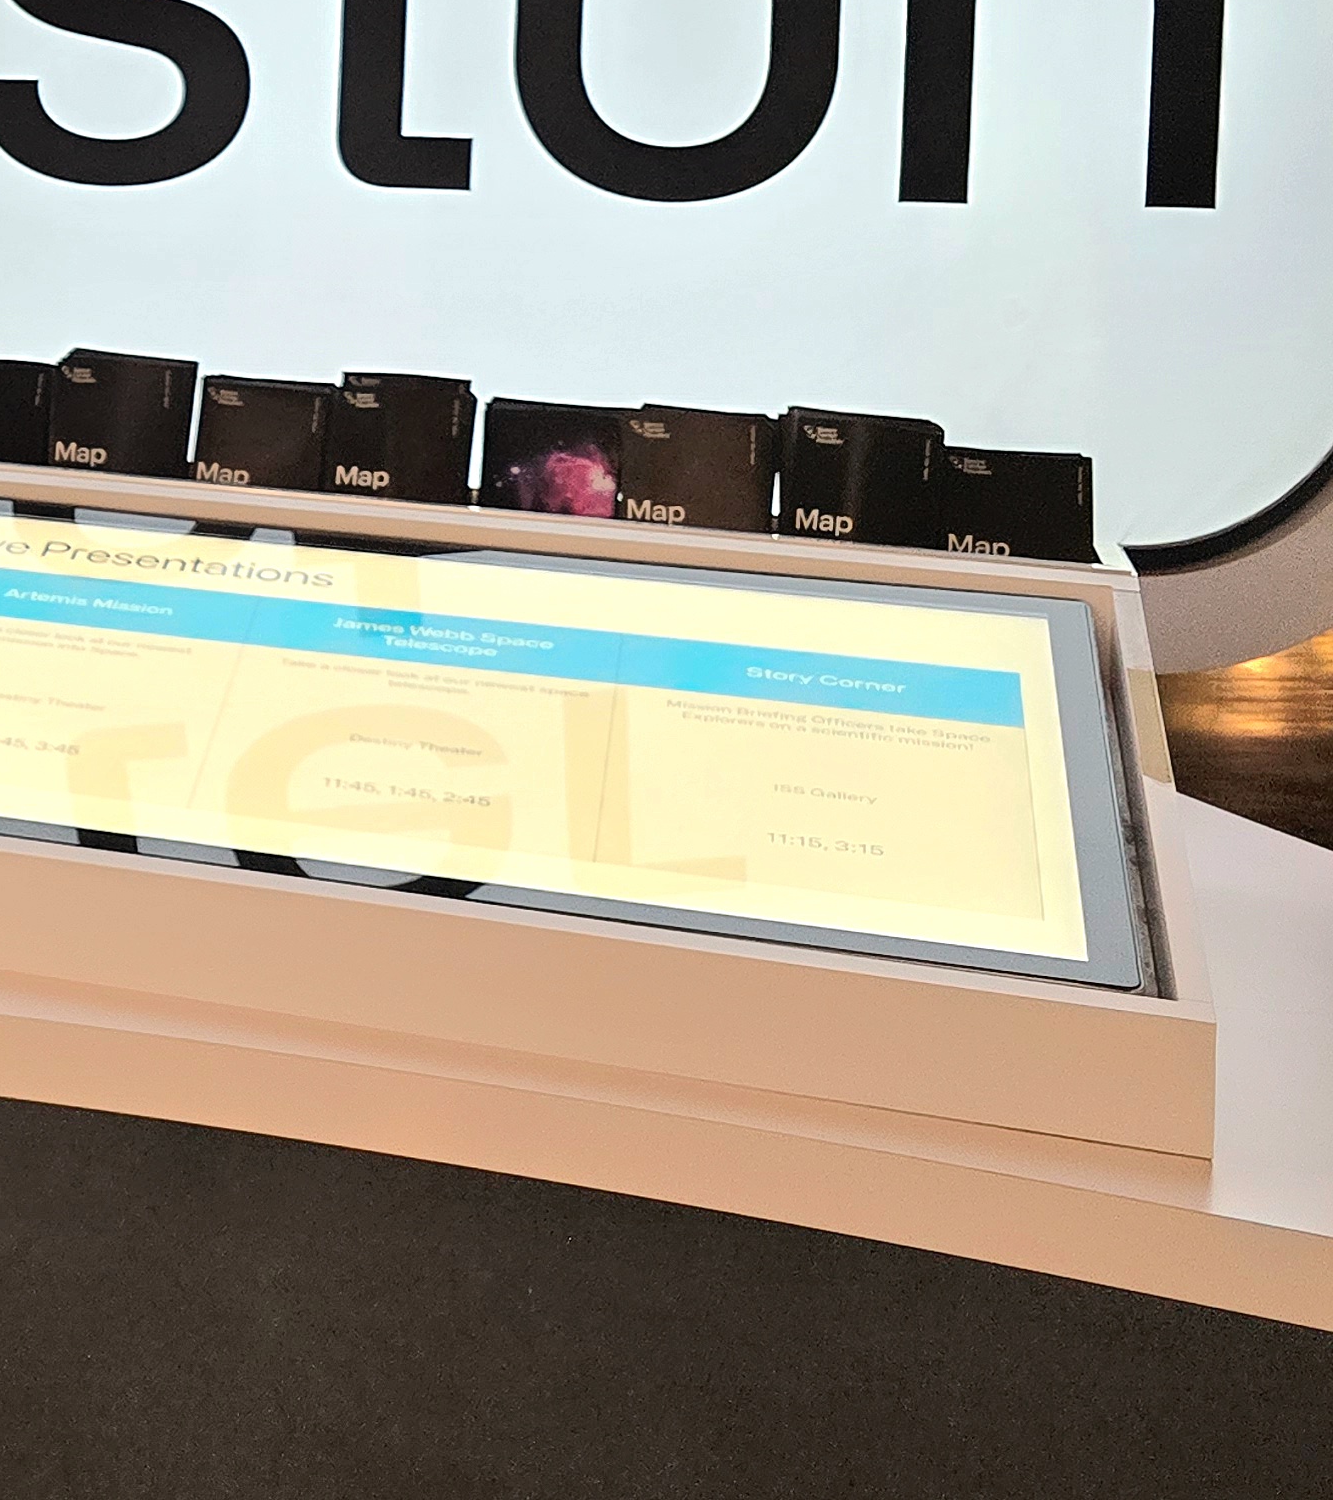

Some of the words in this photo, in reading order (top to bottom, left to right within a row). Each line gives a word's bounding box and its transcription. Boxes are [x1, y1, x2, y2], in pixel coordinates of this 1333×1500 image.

[53, 440, 108, 467] Map
[196, 461, 251, 485] Map
[335, 465, 391, 489] Map
[626, 498, 686, 525] Map
[794, 507, 854, 535] Map
[947, 532, 1011, 557] Map
[41, 541, 335, 588] Presentations
[3, 587, 88, 607] Artemis
[93, 597, 174, 616] Mission
[333, 616, 405, 634] James
[409, 625, 476, 642] Webb
[480, 632, 555, 650] Space
[383, 635, 499, 658] Telescope
[745, 666, 815, 685] Story
[819, 674, 907, 694] Corner
[810, 787, 879, 805] Gallery
[767, 832, 830, 851] 11:15,
[834, 839, 886, 857] 3:15
